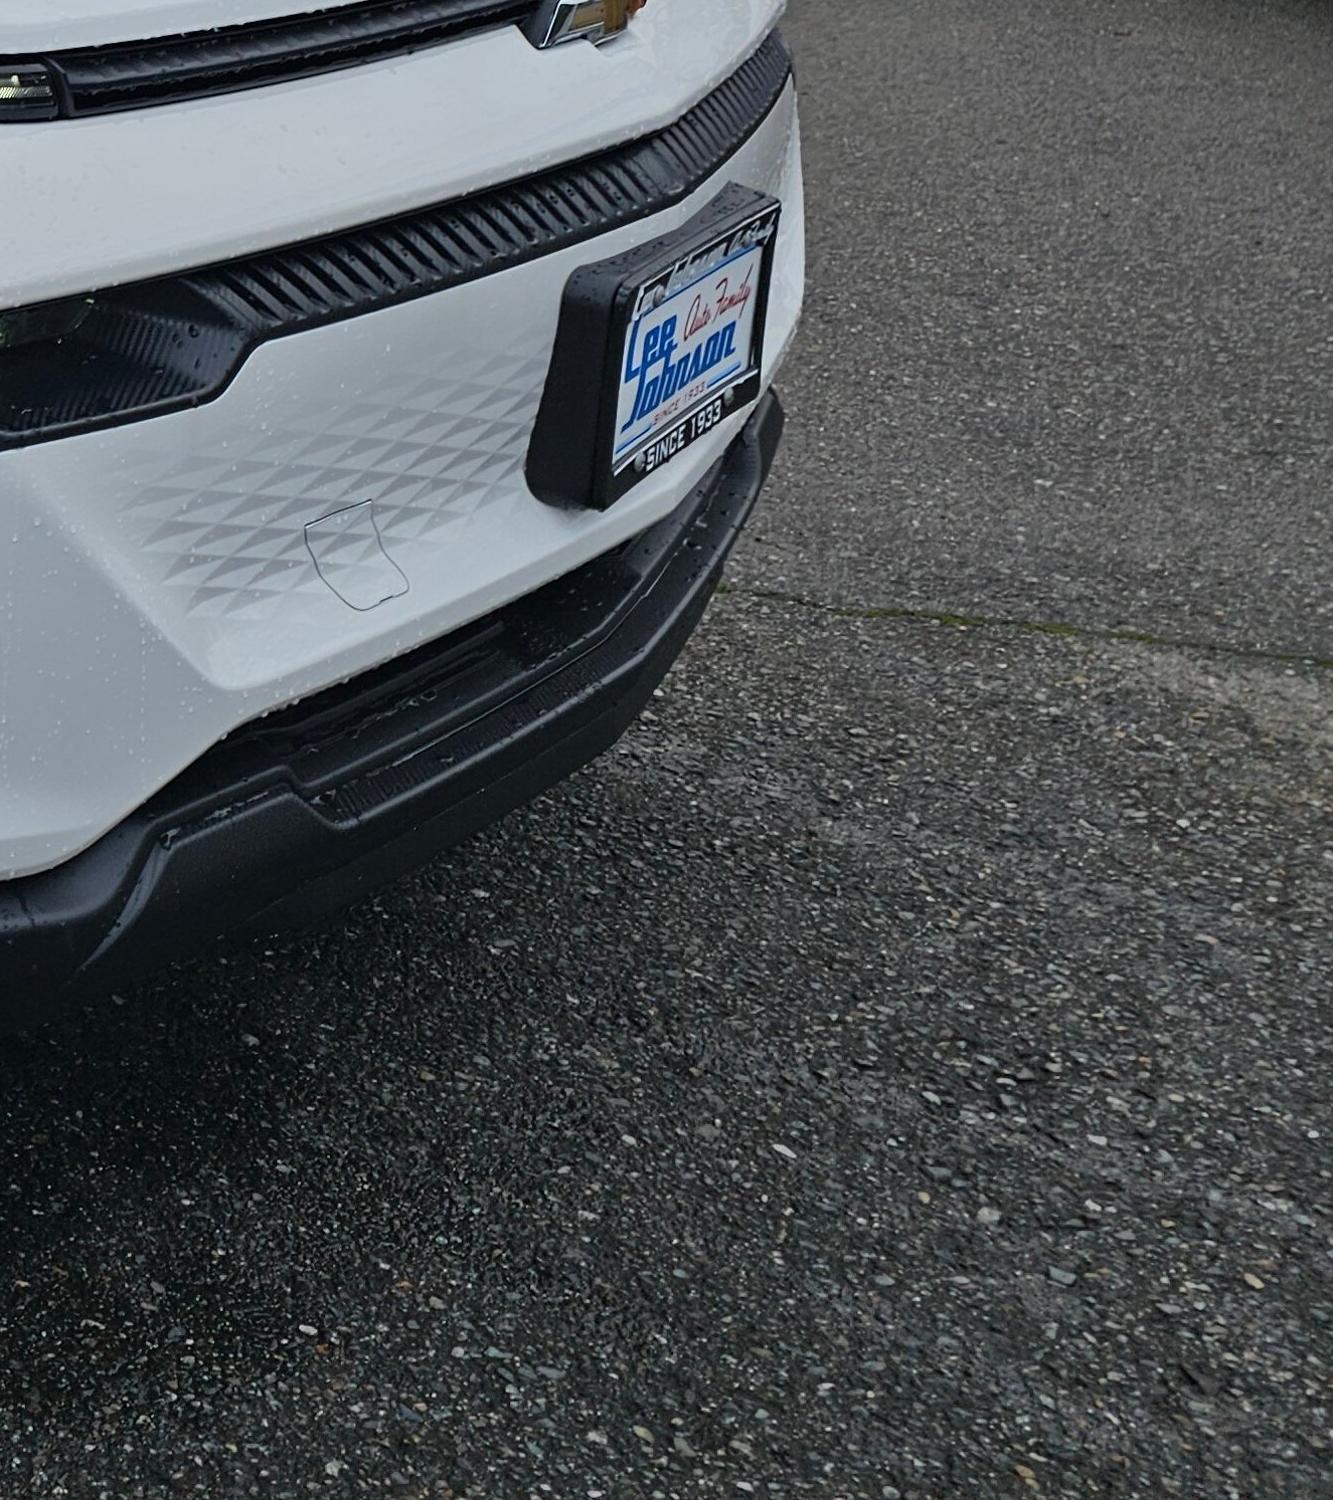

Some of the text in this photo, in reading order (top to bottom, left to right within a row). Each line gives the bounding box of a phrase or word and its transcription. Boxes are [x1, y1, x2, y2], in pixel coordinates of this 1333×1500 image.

[620, 320, 737, 434] Johnson
[624, 314, 678, 384] Lee
[684, 293, 712, 342] Auto
[645, 399, 722, 472] SINCE 1933
